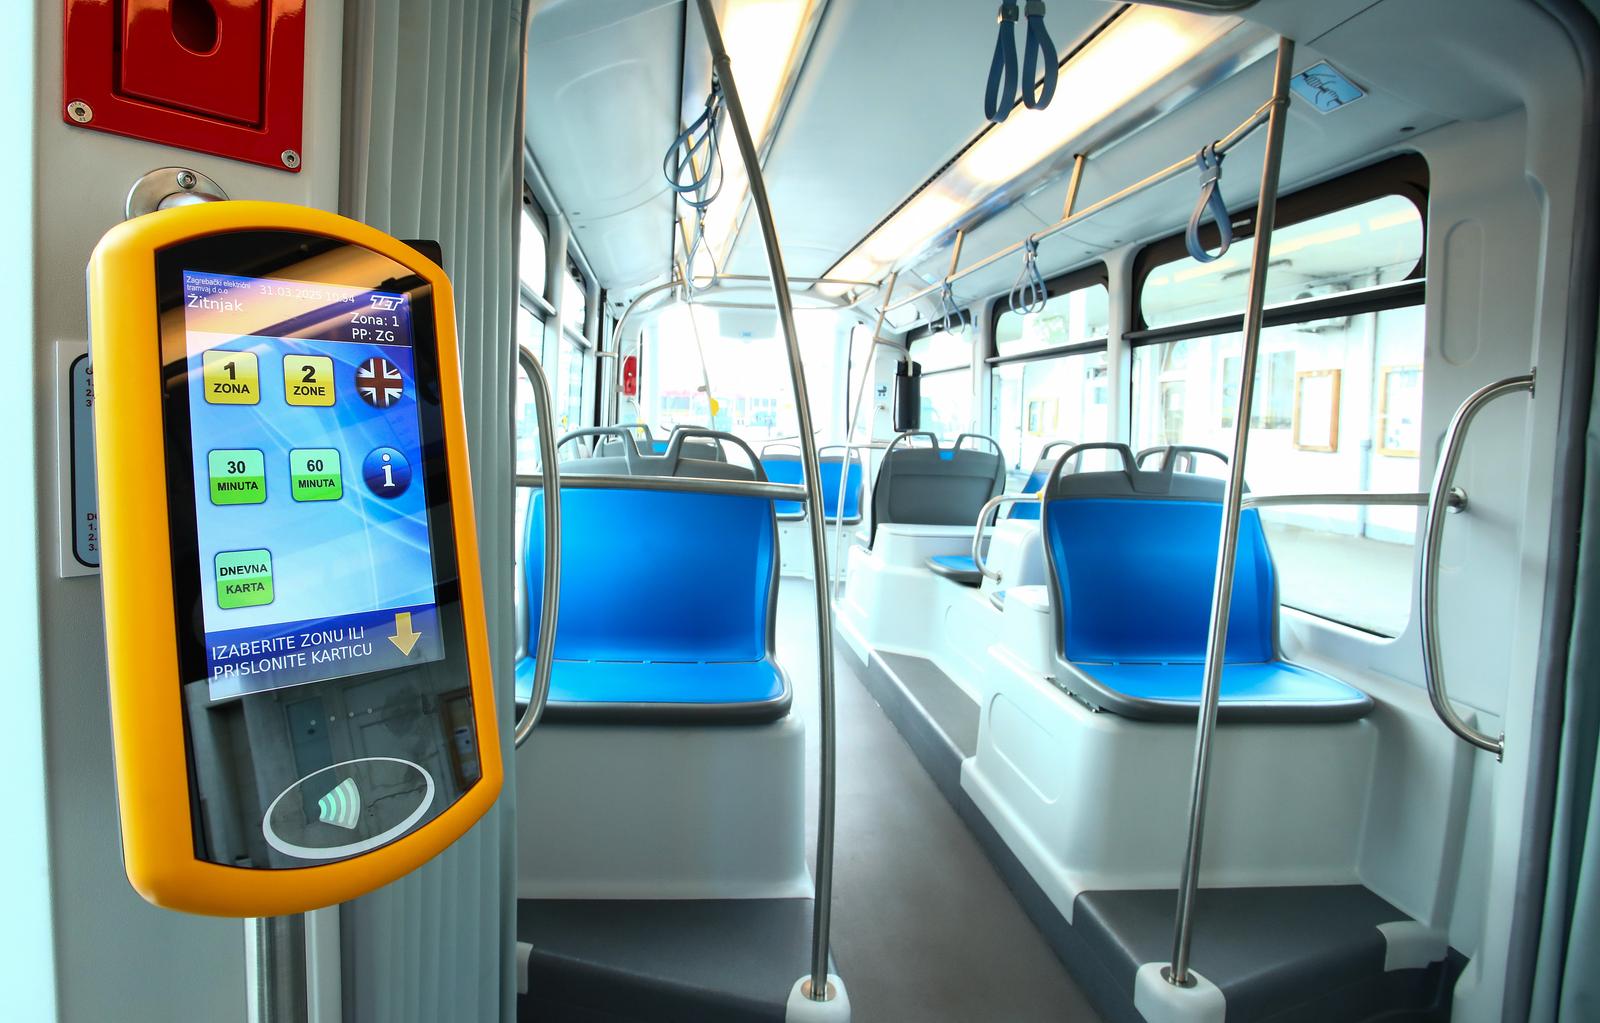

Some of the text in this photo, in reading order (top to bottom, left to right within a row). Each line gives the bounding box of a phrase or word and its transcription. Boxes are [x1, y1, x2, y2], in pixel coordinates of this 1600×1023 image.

[186, 284, 211, 294] tramvaj
[187, 294, 244, 312] Žitnjak
[370, 295, 404, 311] ZET
[350, 312, 400, 327] Zona: 1
[352, 328, 394, 342] PP: ZG
[223, 362, 236, 380] 1
[301, 365, 317, 383] 2
[213, 383, 250, 394] ZONA
[293, 386, 325, 396] ZONE
[227, 460, 246, 474] 30
[307, 459, 324, 472] 60
[217, 481, 259, 492] MINUTA
[298, 479, 336, 489] MINUTA
[219, 563, 268, 577] DNEVNA
[226, 582, 265, 595] KARTA
[212, 626, 365, 661] IZABERITE ZONU ILI
[213, 643, 373, 681] PRISLONITE KARTICU
